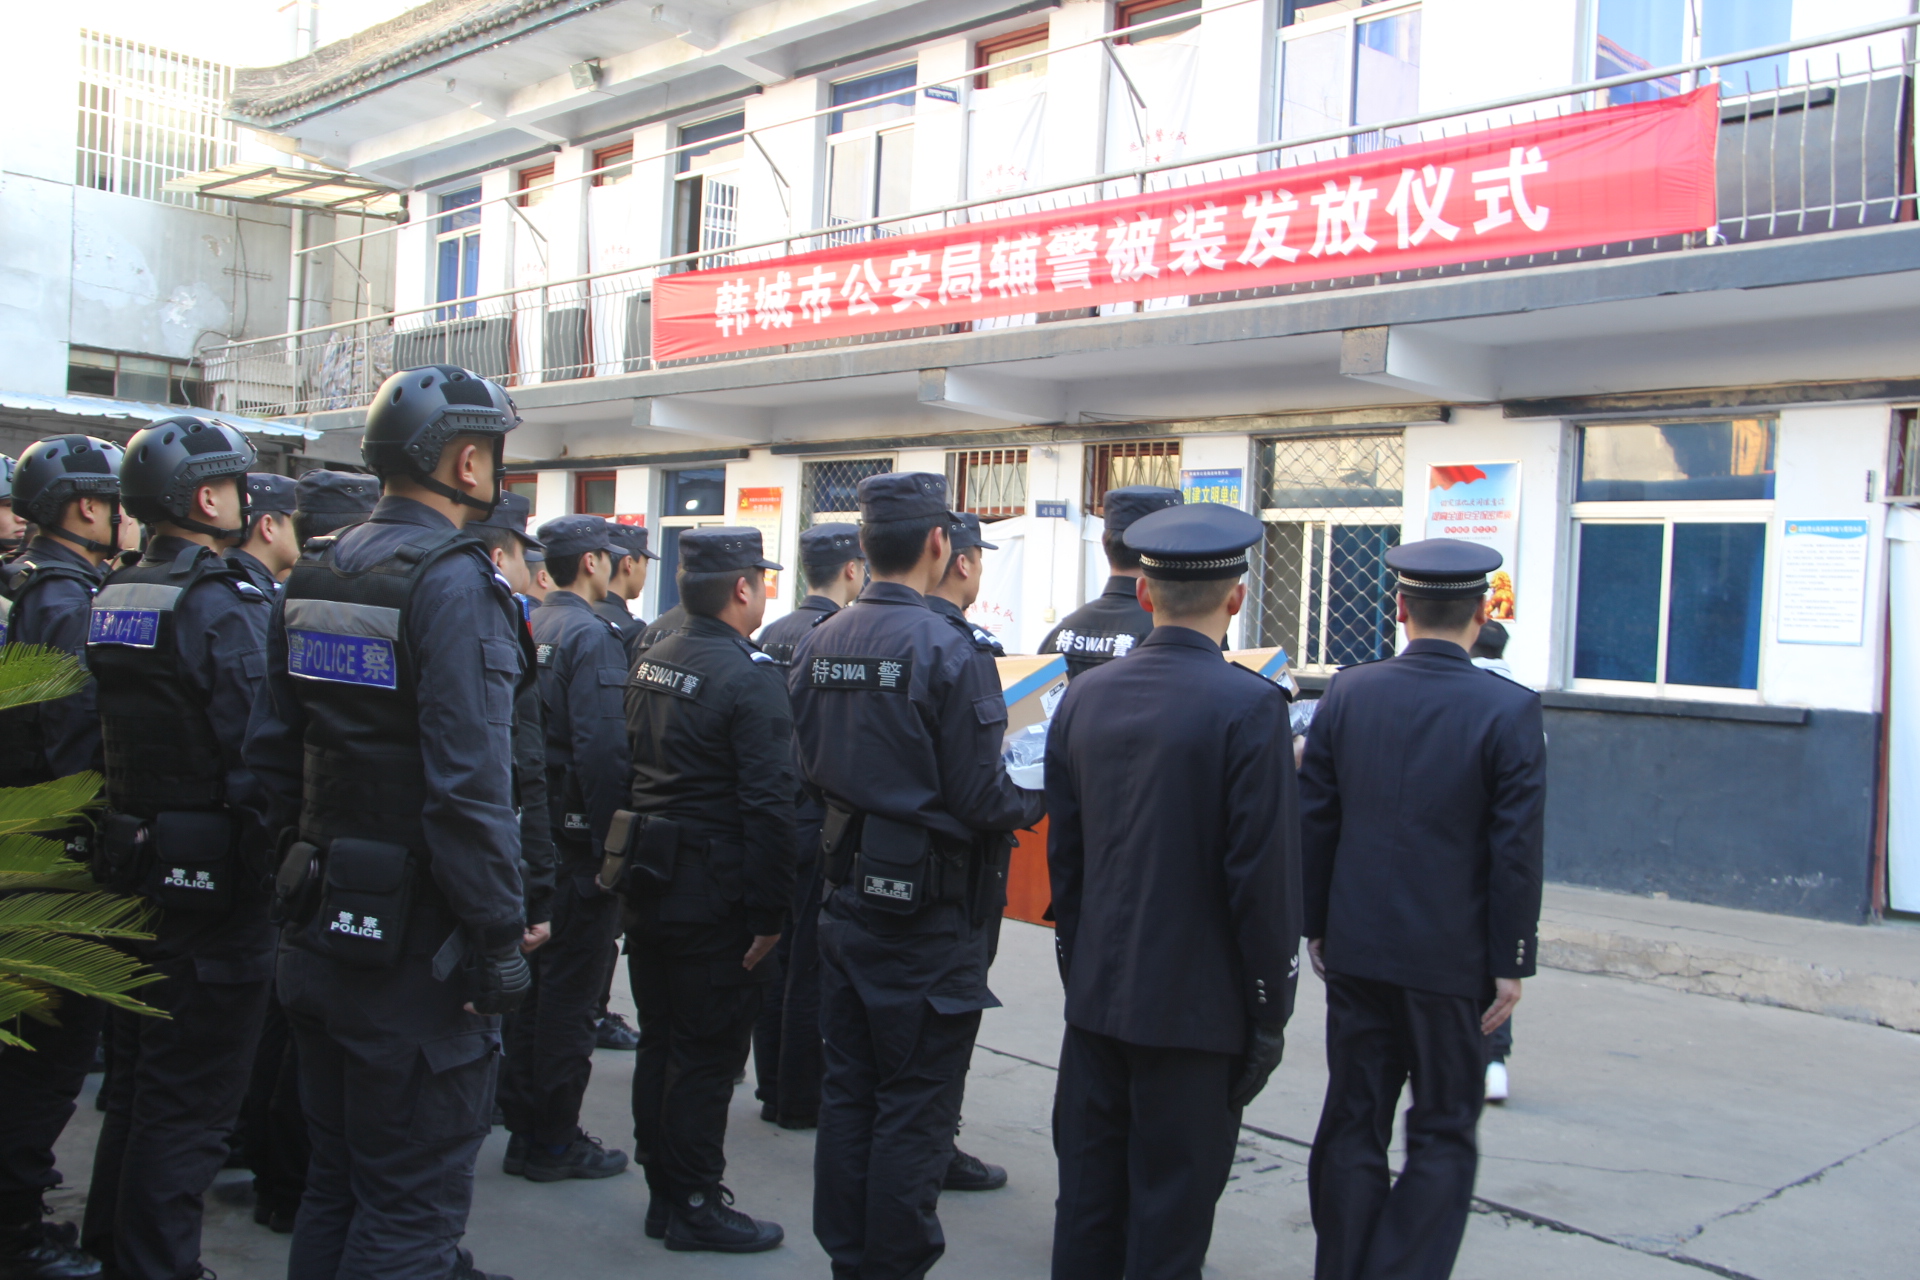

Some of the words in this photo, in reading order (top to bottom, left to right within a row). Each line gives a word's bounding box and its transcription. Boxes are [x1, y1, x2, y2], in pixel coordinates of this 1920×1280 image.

[714, 146, 1551, 338] 韩城市公安局辅警被装发放仪式
[1183, 485, 1239, 504] 创建文明单位
[536, 644, 552, 663] 警
[164, 876, 215, 890] POLICE
[867, 886, 909, 898] POLICE
[330, 921, 382, 939] POLICE
